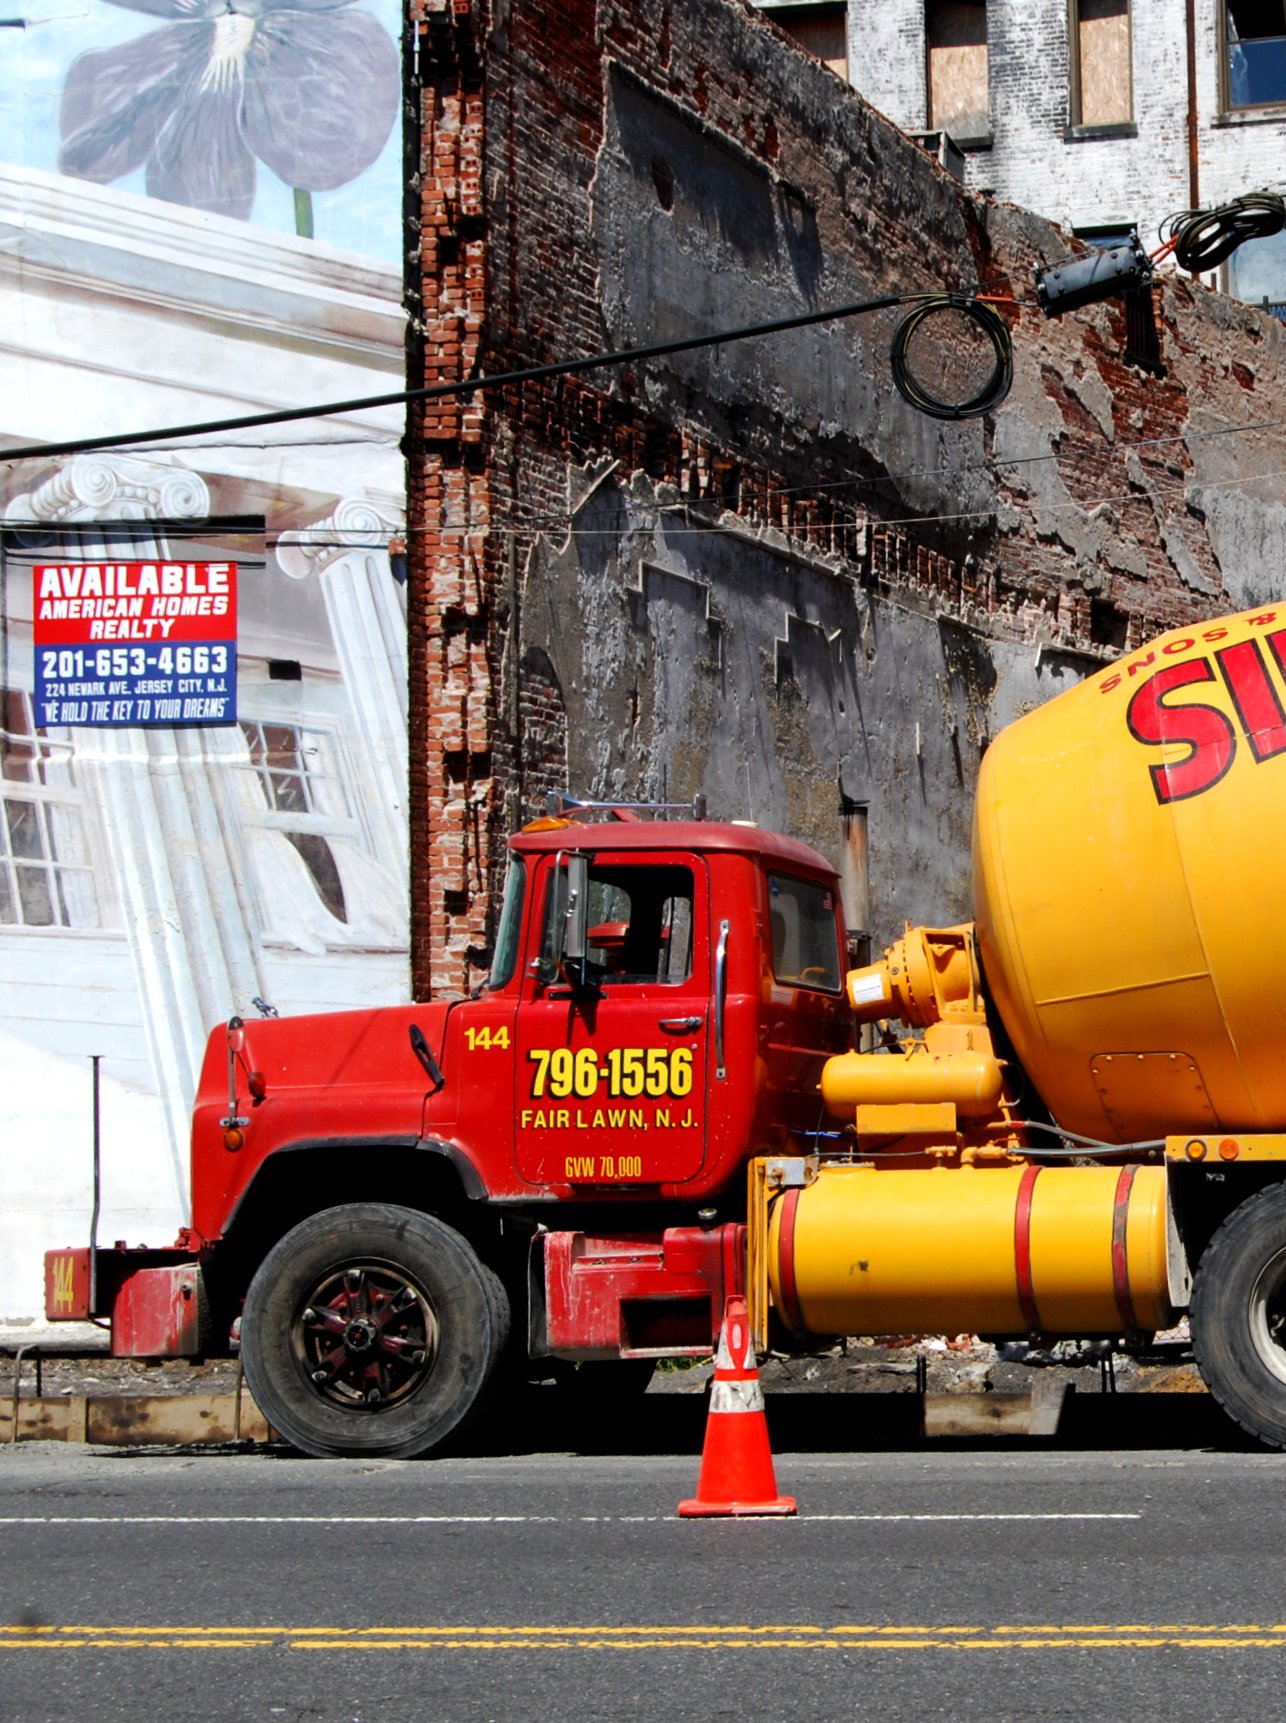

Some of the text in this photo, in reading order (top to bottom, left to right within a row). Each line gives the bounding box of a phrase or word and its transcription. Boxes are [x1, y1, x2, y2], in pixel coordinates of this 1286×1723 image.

[40, 564, 229, 598] AVAILABLE
[39, 596, 228, 620] AMERICAN HOMES
[90, 618, 176, 640] REALTY
[42, 646, 228, 679] 201-653-4663
[1099, 611, 1276, 694] & SONS
[45, 683, 66, 698] 224
[68, 682, 105, 697] NEWARK
[108, 681, 131, 695] AVE.
[134, 680, 173, 694] JERSEY
[206, 678, 228, 693] N.J.
[61, 701, 88, 722] HOLD
[91, 700, 110, 721] THE
[112, 700, 133, 720] KEY
[137, 699, 150, 720] TO
[155, 698, 181, 719] YOUR
[464, 1026, 510, 1050] 144
[529, 1047, 694, 1097] 796-1556
[521, 1109, 570, 1129] FAIR
[576, 1109, 648, 1131] LAWN,
[565, 1156, 642, 1179] GVW 70,000
[52, 1256, 74, 1313] 144
